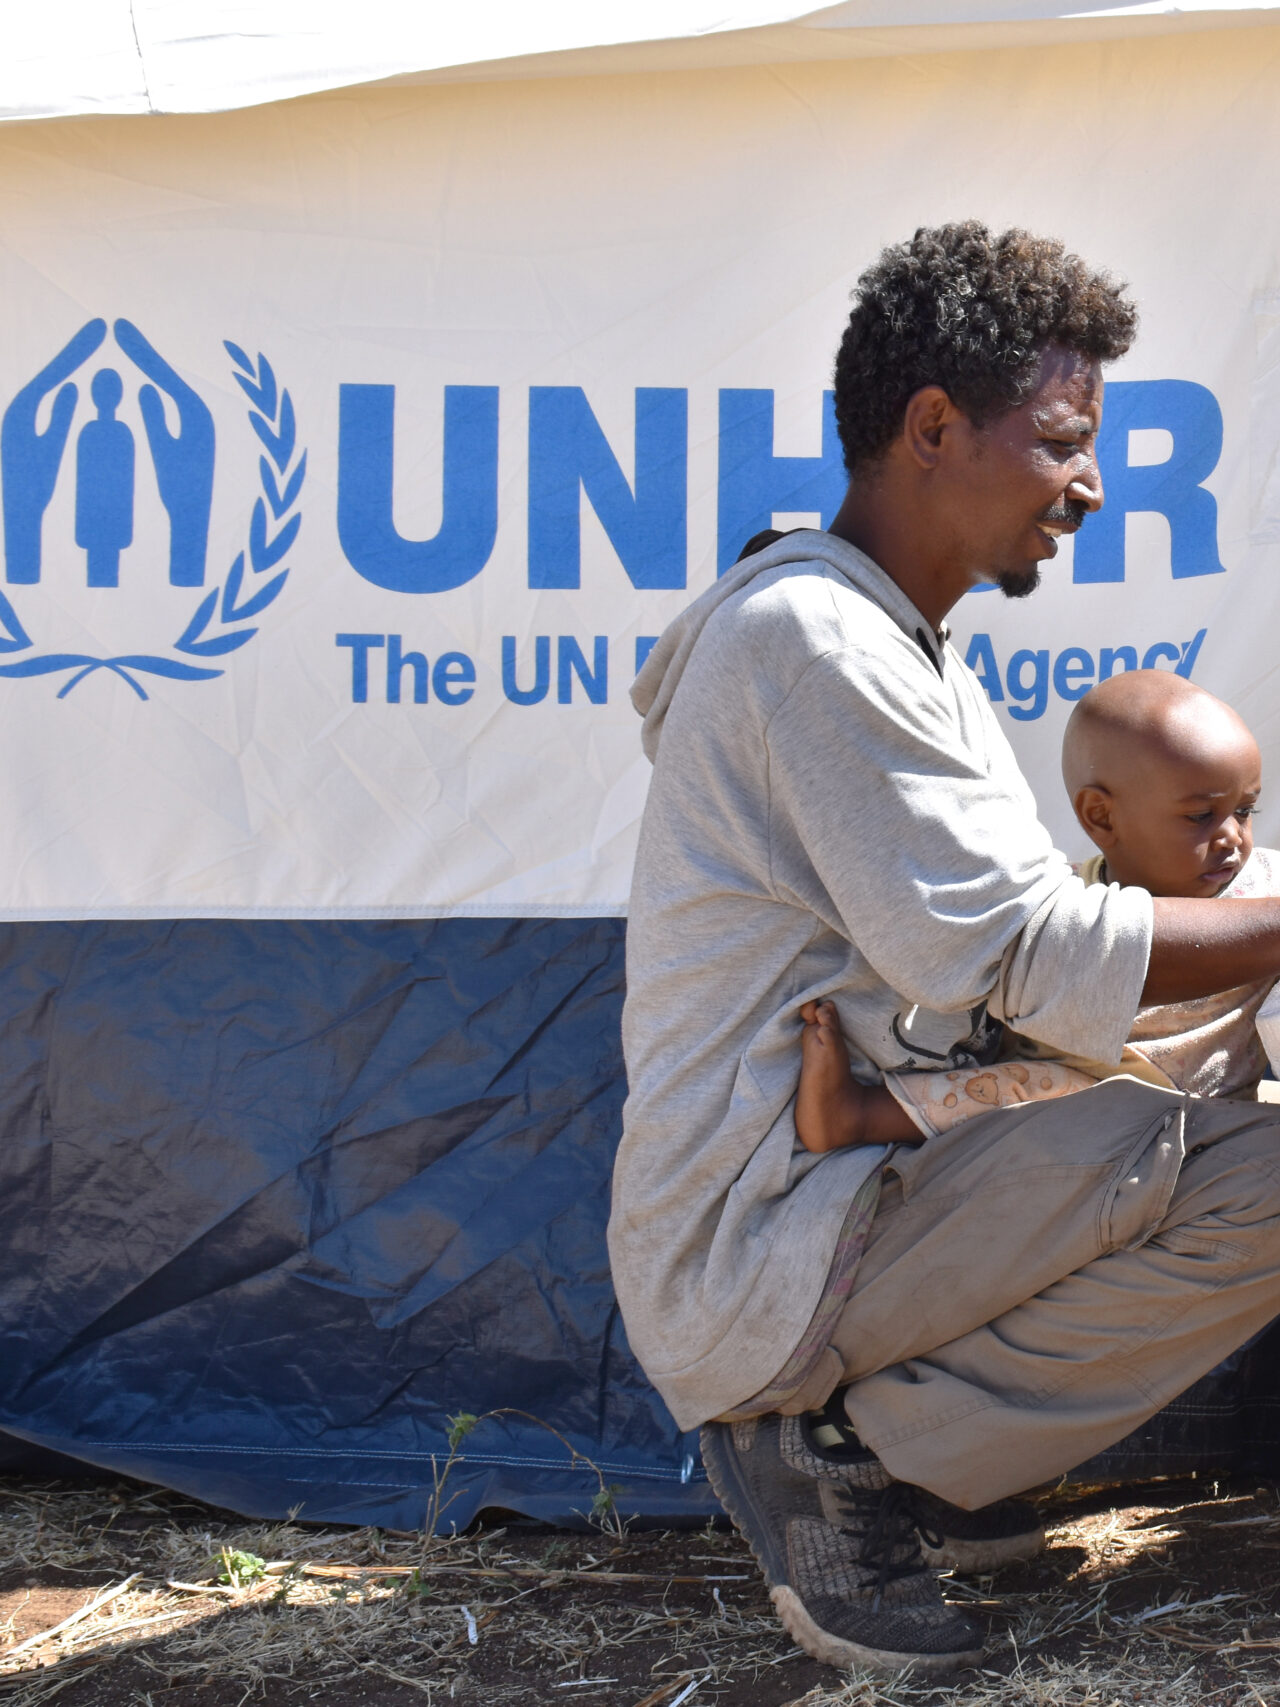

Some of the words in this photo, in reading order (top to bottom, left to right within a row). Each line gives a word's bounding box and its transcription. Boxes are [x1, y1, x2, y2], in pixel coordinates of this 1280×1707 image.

[337, 379, 1225, 594] UNHR
[336, 633, 476, 706] The
[502, 635, 608, 706] UN
